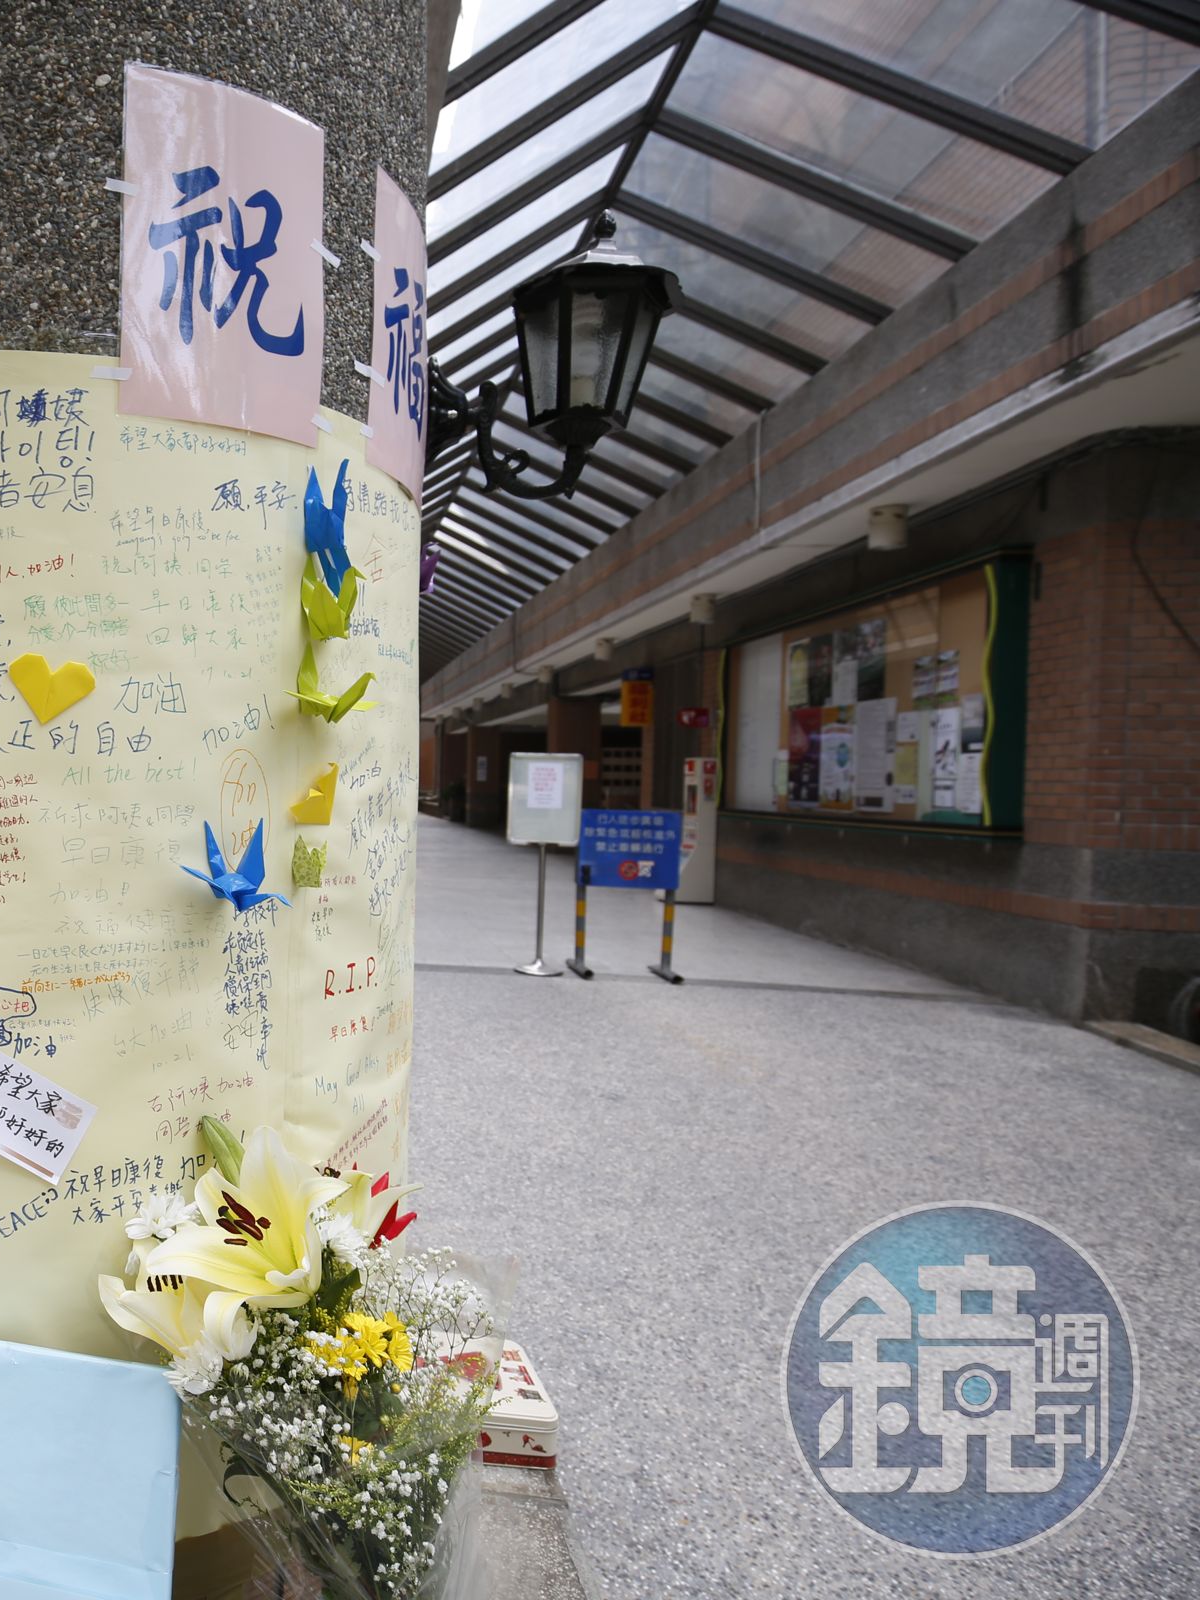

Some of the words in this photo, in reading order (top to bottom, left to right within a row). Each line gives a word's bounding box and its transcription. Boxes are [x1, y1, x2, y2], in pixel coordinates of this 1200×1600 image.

[149, 166, 304, 356] 祝
[385, 268, 425, 441] 福
[114, 671, 187, 714] 加油
[202, 694, 275, 755] 加油!
[61, 765, 91, 786] All
[104, 762, 137, 783] the
[13, 1032, 57, 1059] 加油
[315, 1076, 338, 1104] May
